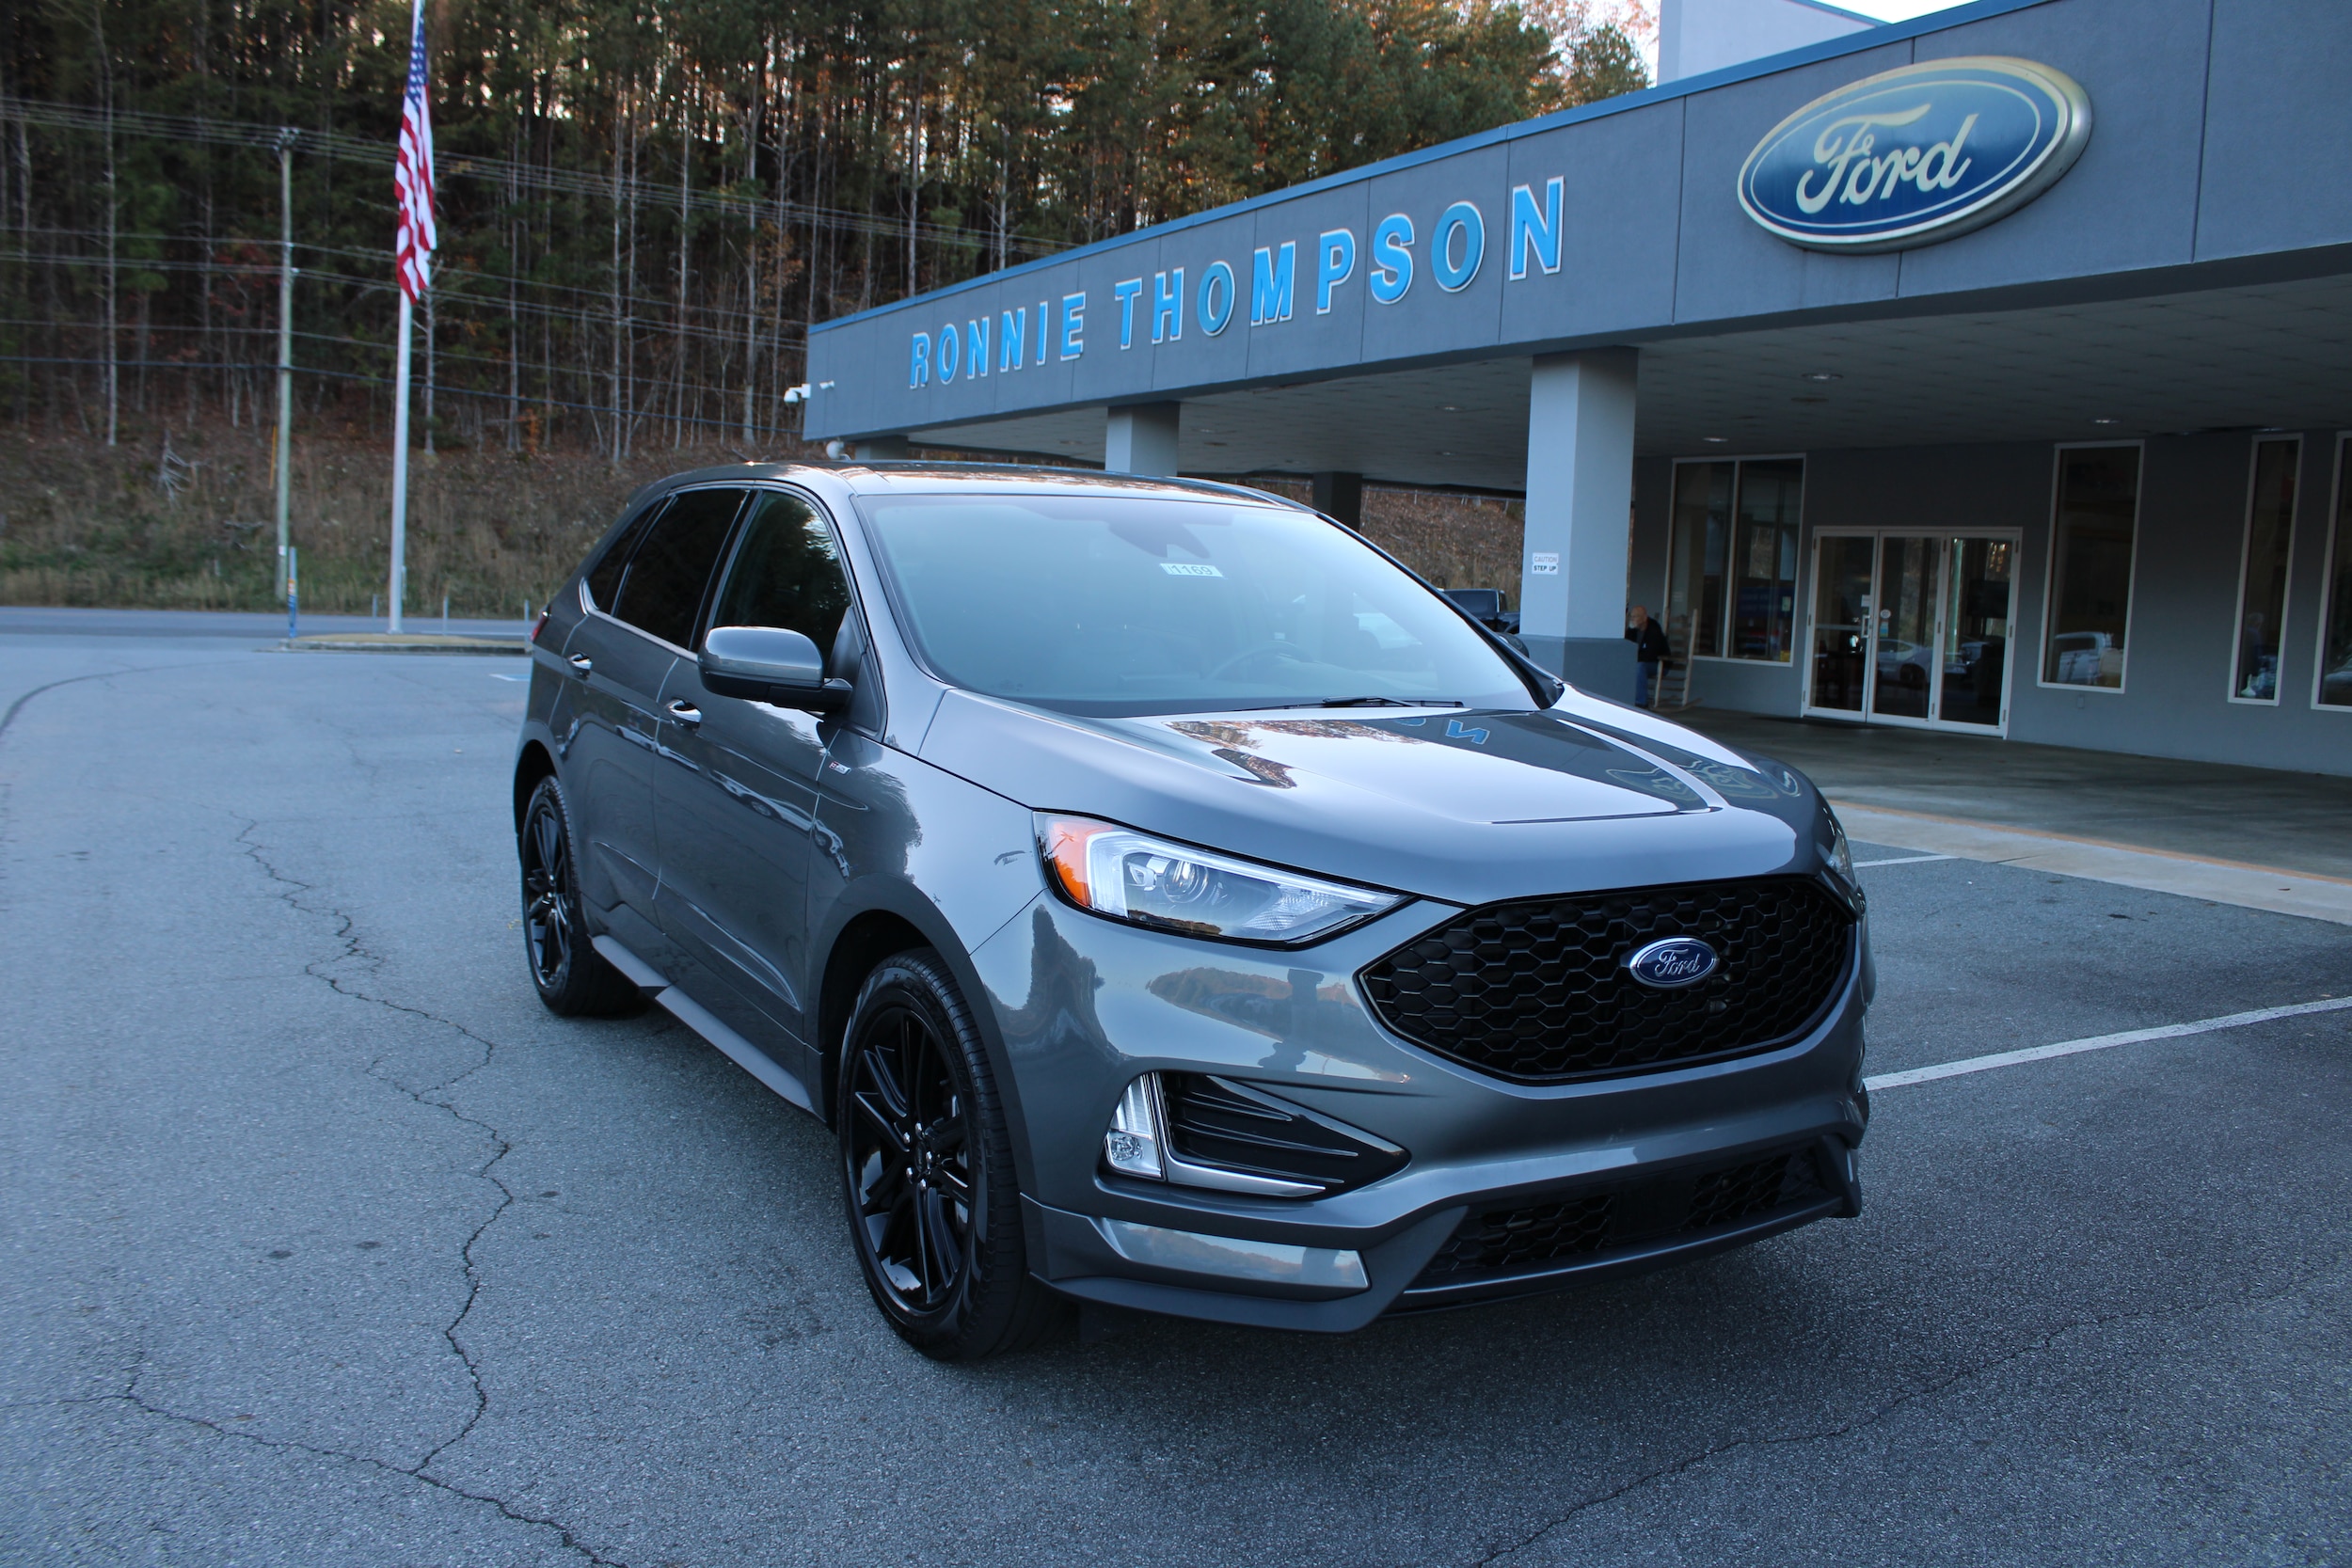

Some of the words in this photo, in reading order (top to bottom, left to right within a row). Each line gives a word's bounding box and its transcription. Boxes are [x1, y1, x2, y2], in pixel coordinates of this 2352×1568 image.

[1795, 103, 1979, 214] Ford
[910, 291, 1086, 389] RONNIE
[1114, 175, 1565, 349] THOMPSON
[1654, 948, 1701, 977] Ford
